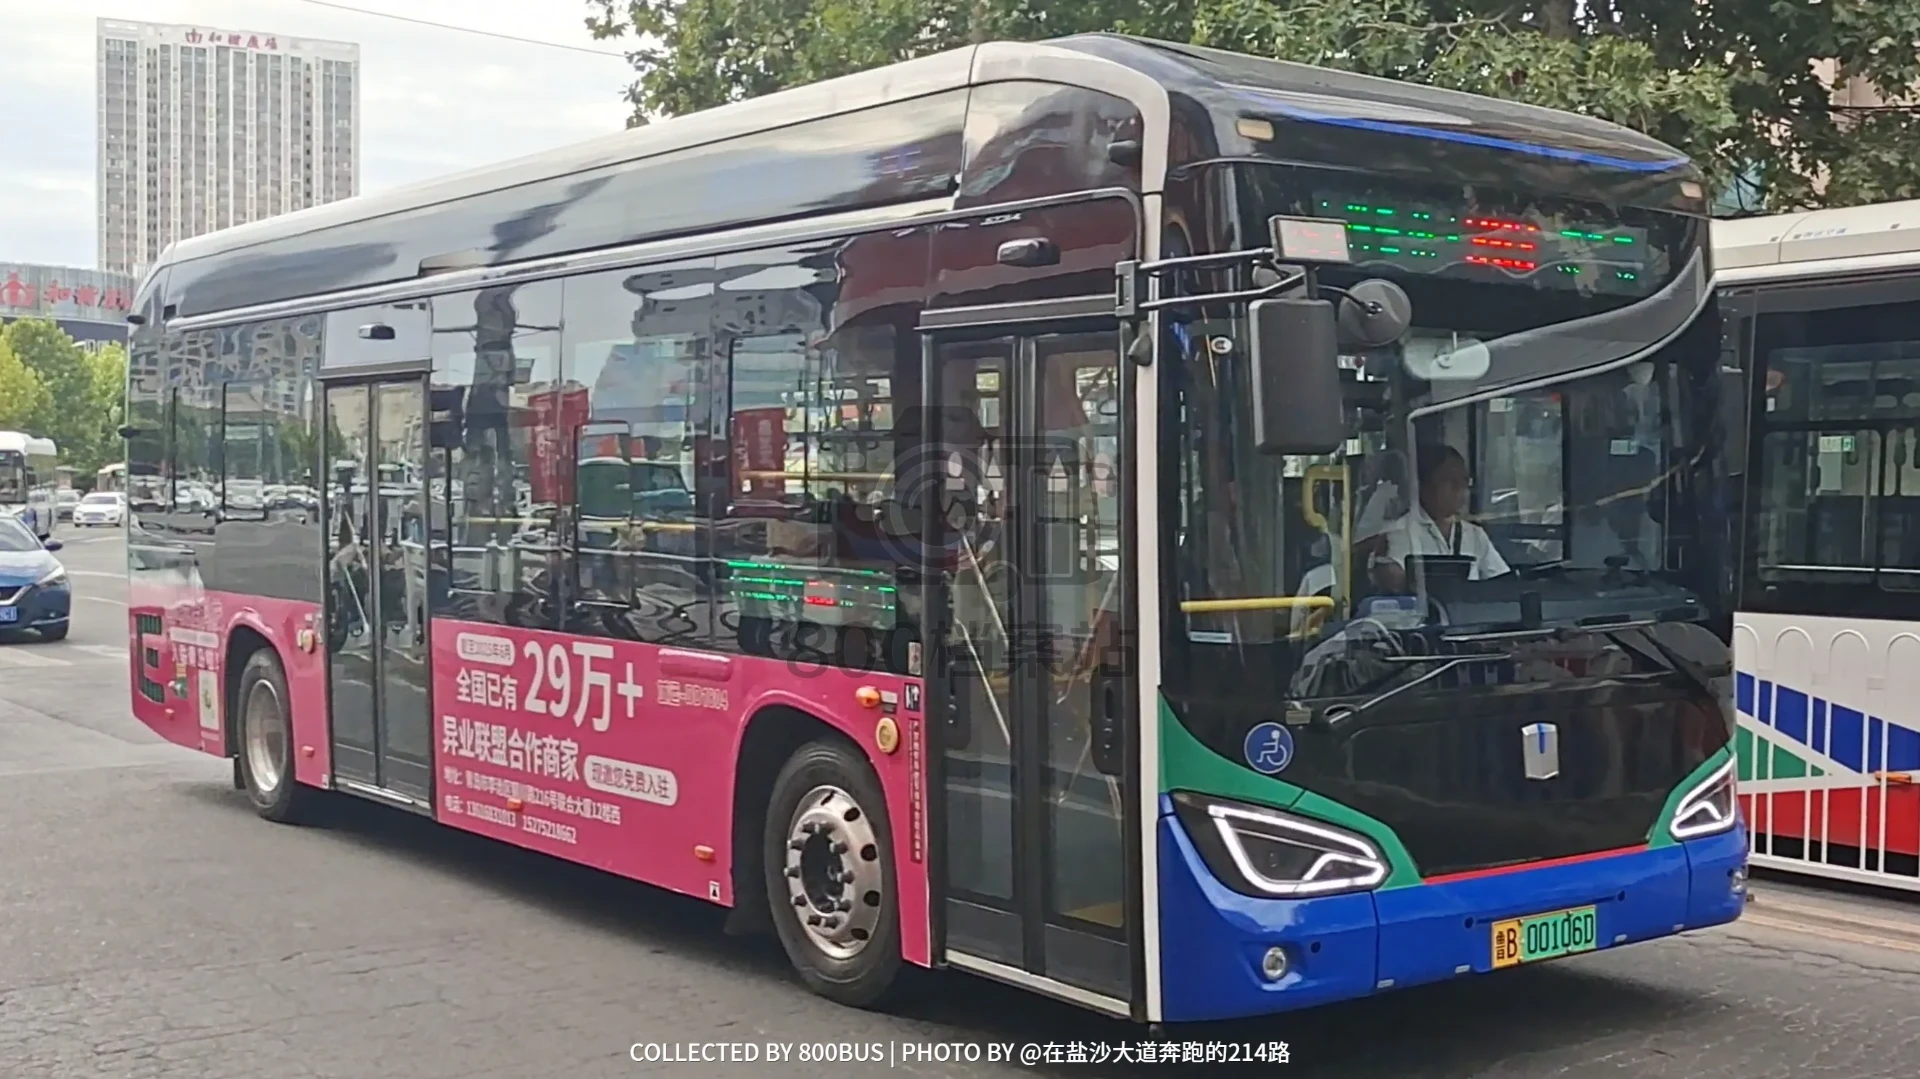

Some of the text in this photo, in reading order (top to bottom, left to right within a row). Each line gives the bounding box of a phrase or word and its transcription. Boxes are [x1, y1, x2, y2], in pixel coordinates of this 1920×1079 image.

[456, 667, 518, 711] 全国已有
[523, 640, 643, 732] 29万+
[442, 715, 580, 782] 异业联盟合作商家
[1527, 913, 1595, 954] 00106D
